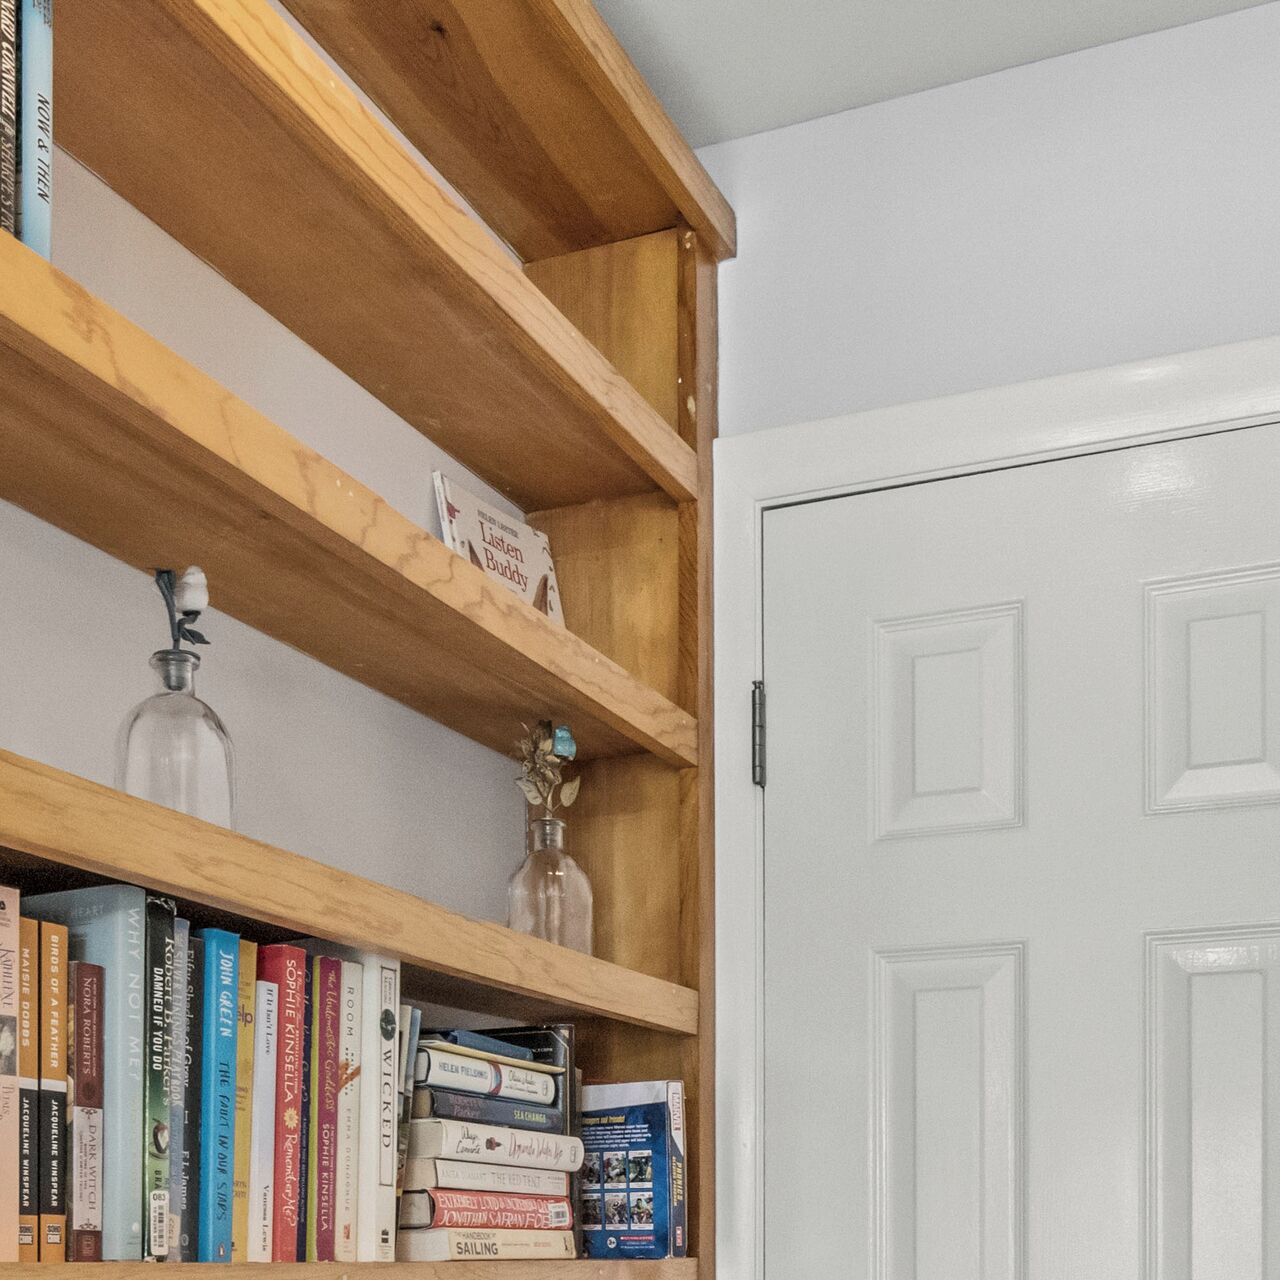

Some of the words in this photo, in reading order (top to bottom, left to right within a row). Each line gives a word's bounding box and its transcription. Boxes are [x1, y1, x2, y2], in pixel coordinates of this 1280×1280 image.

[1, 42, 15, 120] CORNWELL
[38, 94, 50, 139] NOW
[37, 139, 49, 153] &
[37, 157, 50, 204] THEN
[479, 520, 524, 564] Listen
[483, 547, 528, 592] Buddy
[22, 948, 30, 995] MAISIE
[51, 935, 59, 974] BIRDS
[220, 950, 233, 985] JOHN
[51, 979, 59, 994] OF
[51, 998, 59, 1007] A
[153, 967, 164, 1012] DAMNED
[286, 960, 296, 1017] SOPHIE
[22, 1001, 30, 1047] DOBBS
[153, 1015, 164, 1027] IF
[220, 991, 233, 1037] GREEN
[346, 987, 354, 1036] ROOM
[50, 1011, 59, 1069] FEATHER
[153, 1029, 163, 1056] YOU
[153, 1058, 162, 1071] DO
[284, 1024, 296, 1103] KINSELLA
[382, 1050, 392, 1148] WICKED
[89, 1124, 97, 1160] DARK
[322, 1124, 330, 1168] SOPHIE
[89, 1166, 97, 1211] WITCH
[322, 1172, 330, 1231] KINSELLA
[438, 1210, 488, 1227] JONATHAN
[489, 1212, 525, 1228] SAFRAN
[456, 1242, 499, 1255] SAILING
